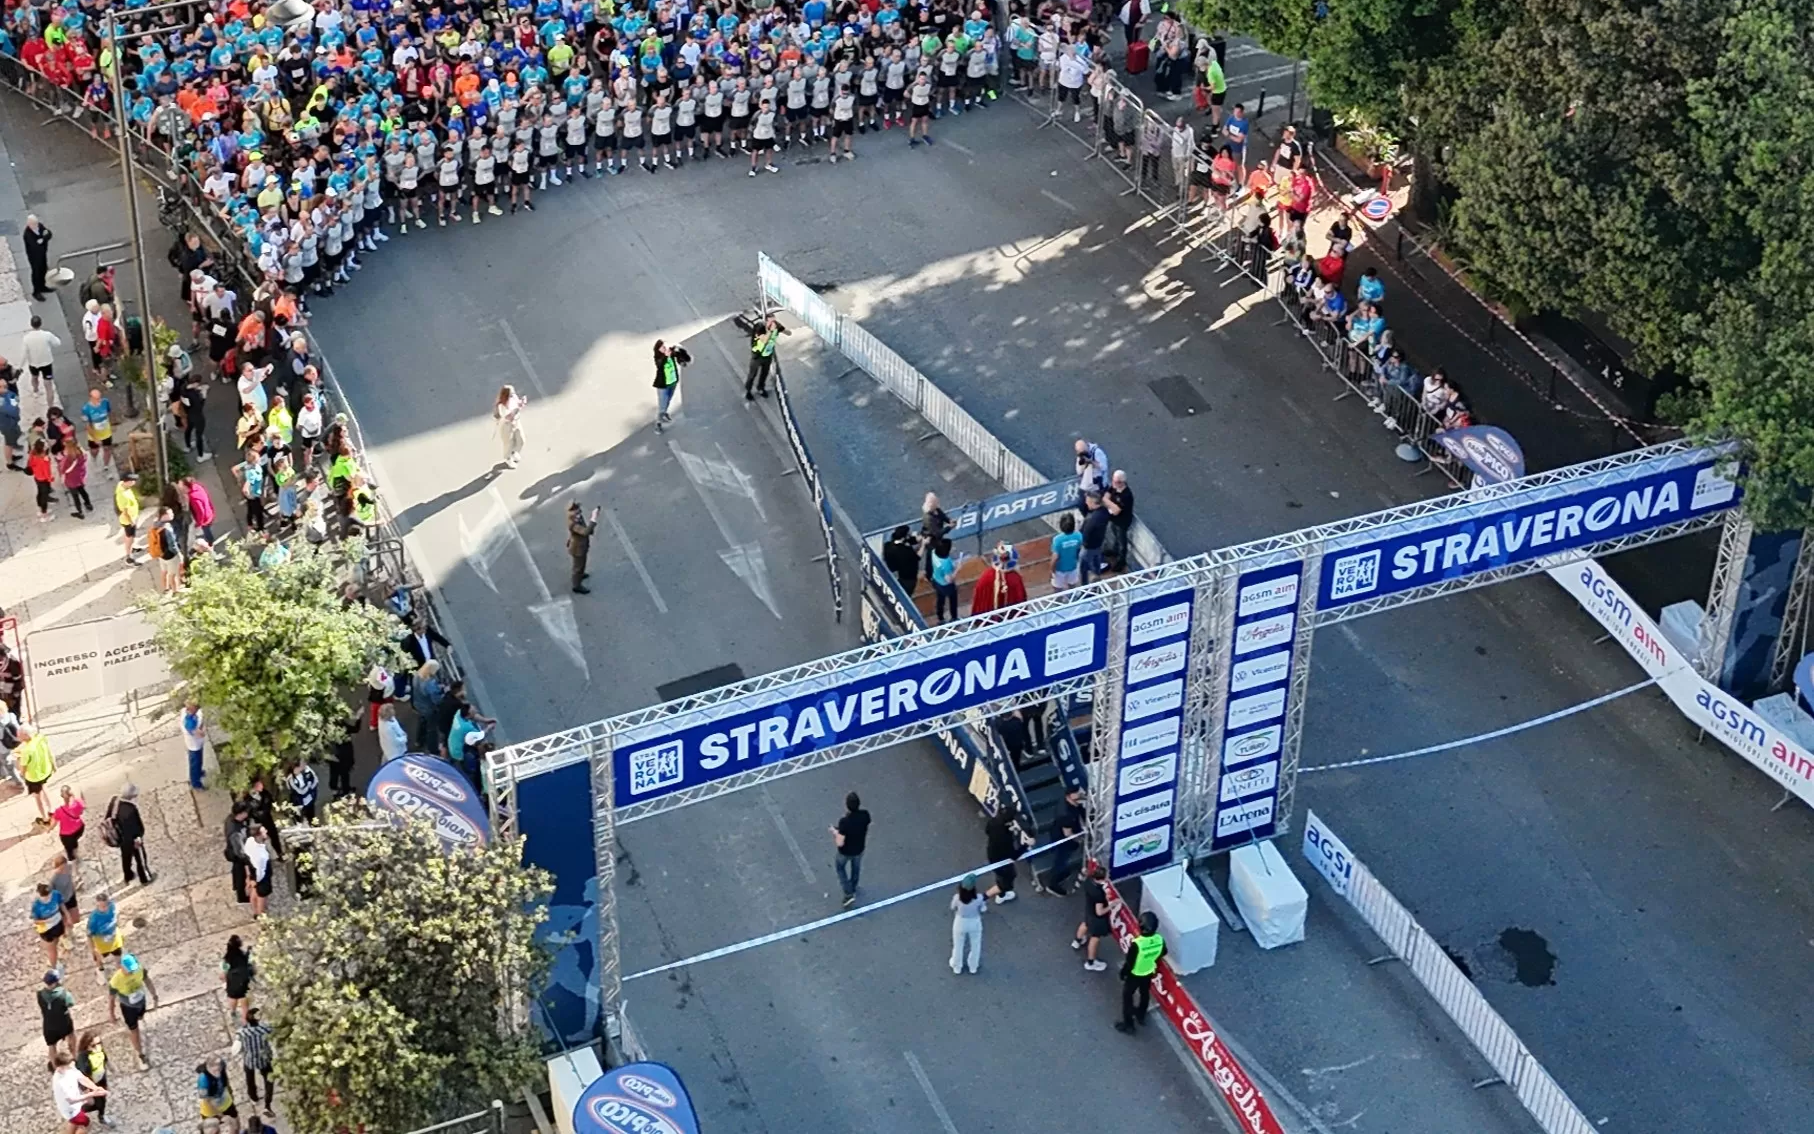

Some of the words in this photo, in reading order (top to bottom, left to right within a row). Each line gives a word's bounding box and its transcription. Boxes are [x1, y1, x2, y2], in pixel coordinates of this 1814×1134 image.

[1484, 451, 1508, 480] PICO
[1392, 480, 1680, 580] STRAVERONA
[105, 638, 157, 658] ACCESS
[34, 651, 98, 669] INGRESSO
[47, 663, 89, 677] ARENA
[104, 652, 141, 667] PIAZZA
[700, 648, 1031, 770] STRAVERONA
[1763, 757, 1798, 785] ENERGIE
[1220, 806, 1270, 827] L'Arena
